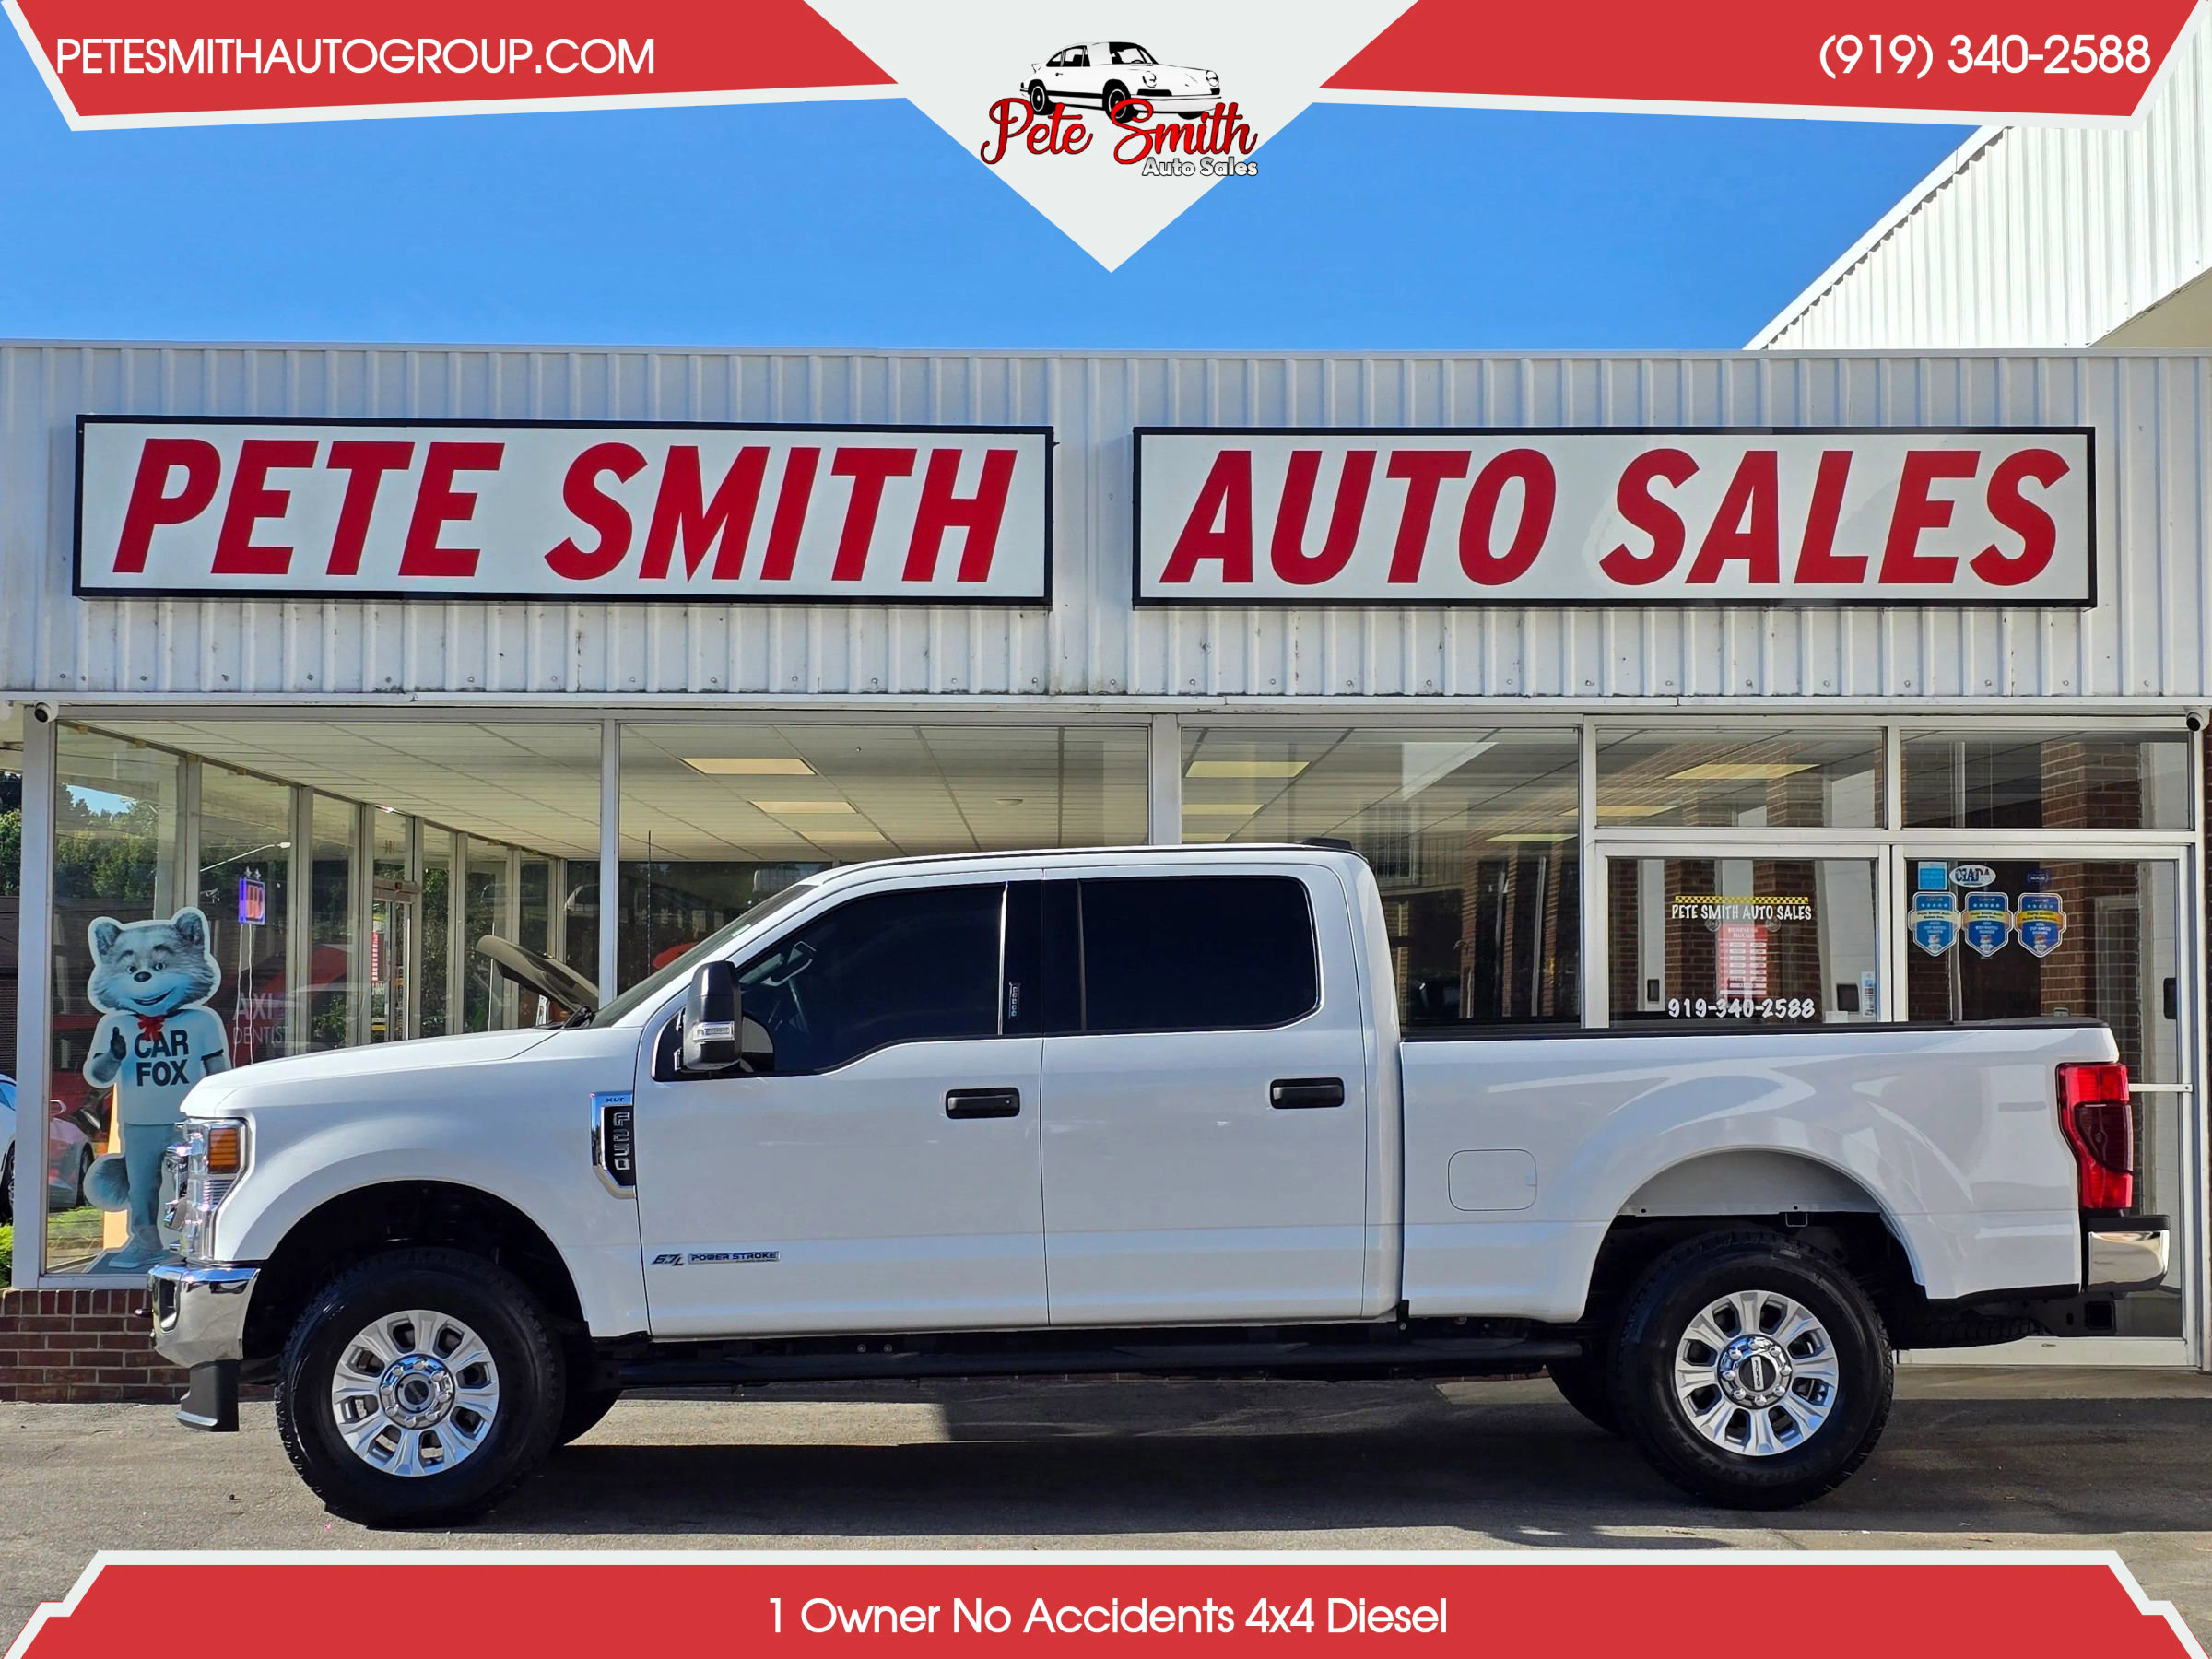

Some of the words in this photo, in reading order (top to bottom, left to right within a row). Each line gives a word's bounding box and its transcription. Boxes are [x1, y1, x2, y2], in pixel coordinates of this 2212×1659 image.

[112, 438, 507, 577] PETE
[544, 441, 1018, 582] SMITH
[1159, 448, 1558, 586] AUTO
[1599, 448, 2071, 587] SALES
[1671, 904, 1699, 920] PETE
[1700, 905, 1739, 920] SMITH
[1742, 905, 1774, 920] AUTO
[1776, 905, 1812, 921] SALES
[1668, 998, 1816, 1018] 919-340-2588
[134, 1030, 189, 1059] CAR
[135, 1059, 190, 1087] FOX
[691, 1253, 730, 1262] POWER
[732, 1251, 777, 1260] STROKE
